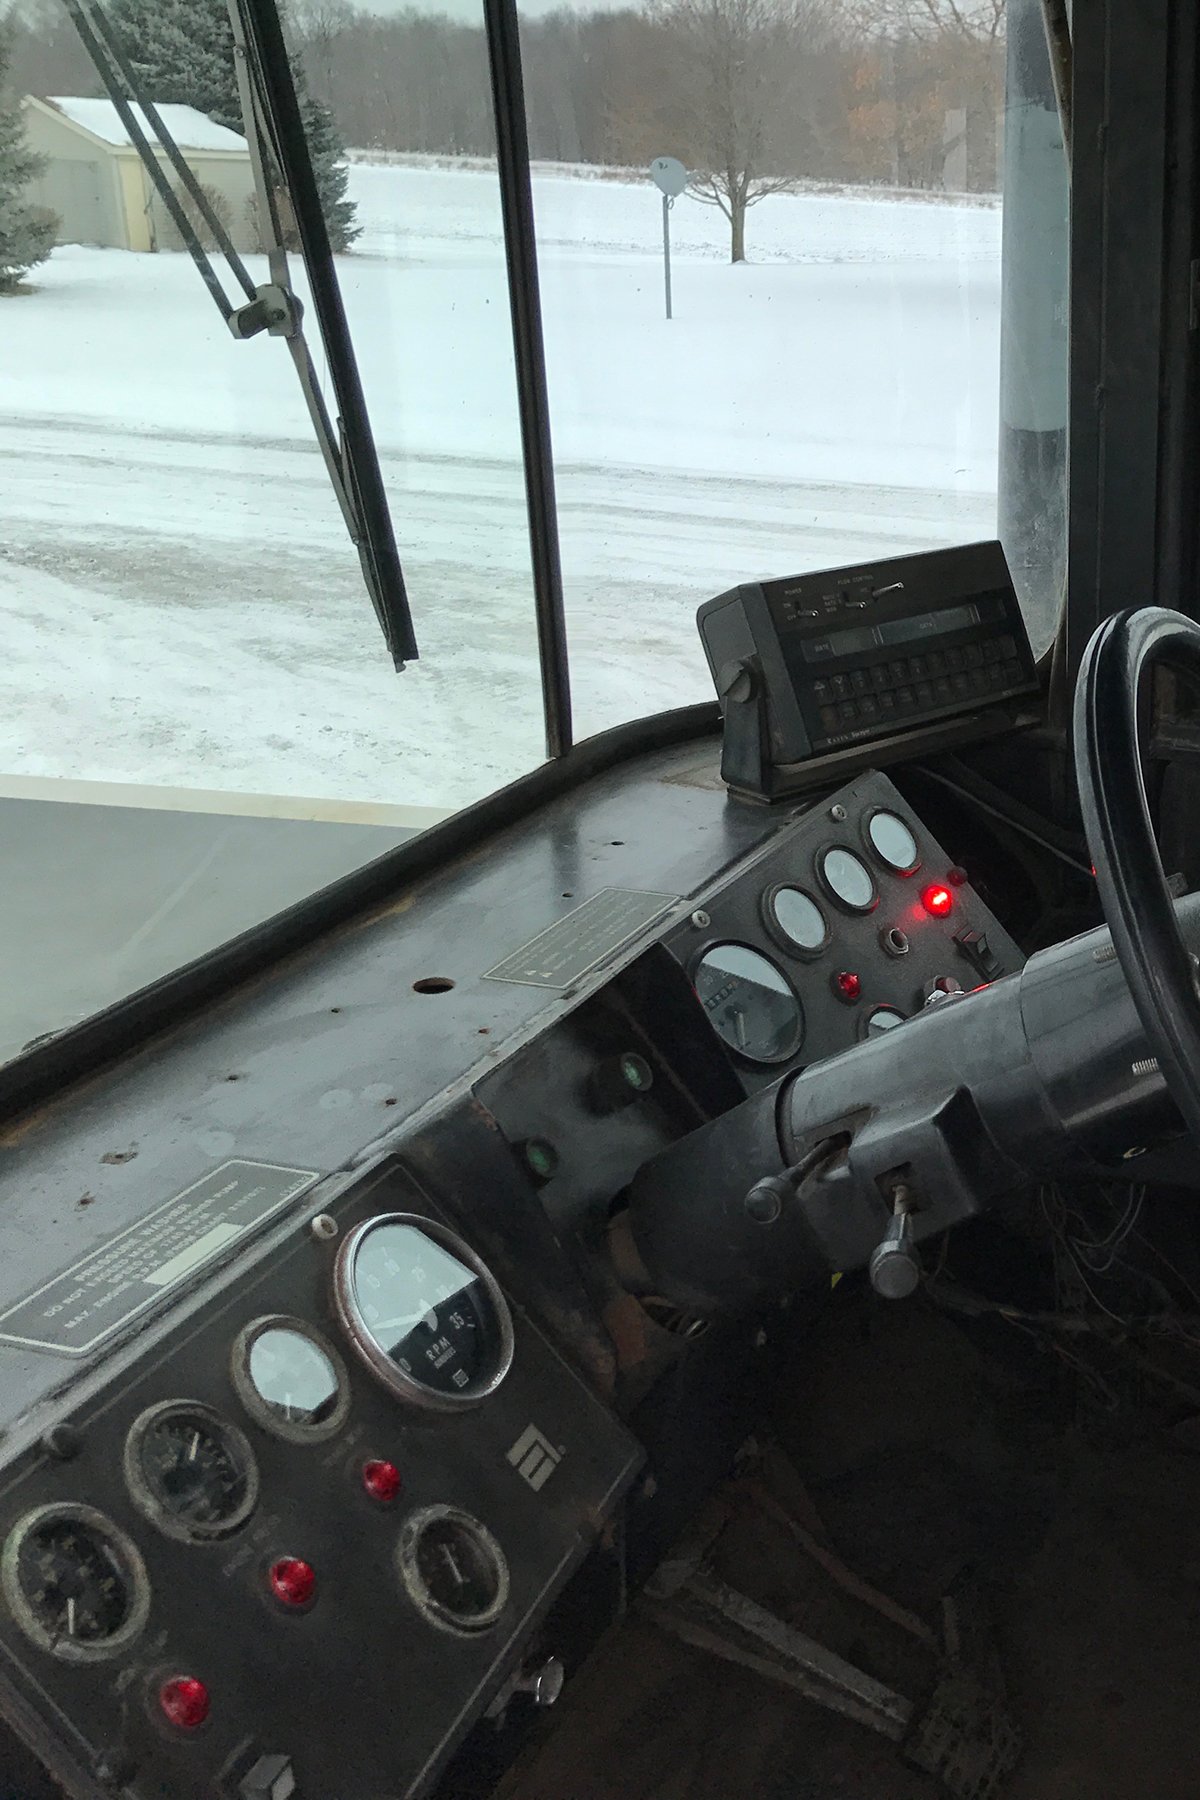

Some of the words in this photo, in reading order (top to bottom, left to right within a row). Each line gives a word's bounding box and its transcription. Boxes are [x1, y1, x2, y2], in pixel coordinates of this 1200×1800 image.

[74, 1239, 140, 1281] PRESSURE
[140, 1204, 191, 1235] WASHER
[44, 1305, 63, 1316] DO
[62, 1289, 86, 1302] NOT
[449, 1312, 465, 1330] 35
[426, 1336, 451, 1361] RPM
